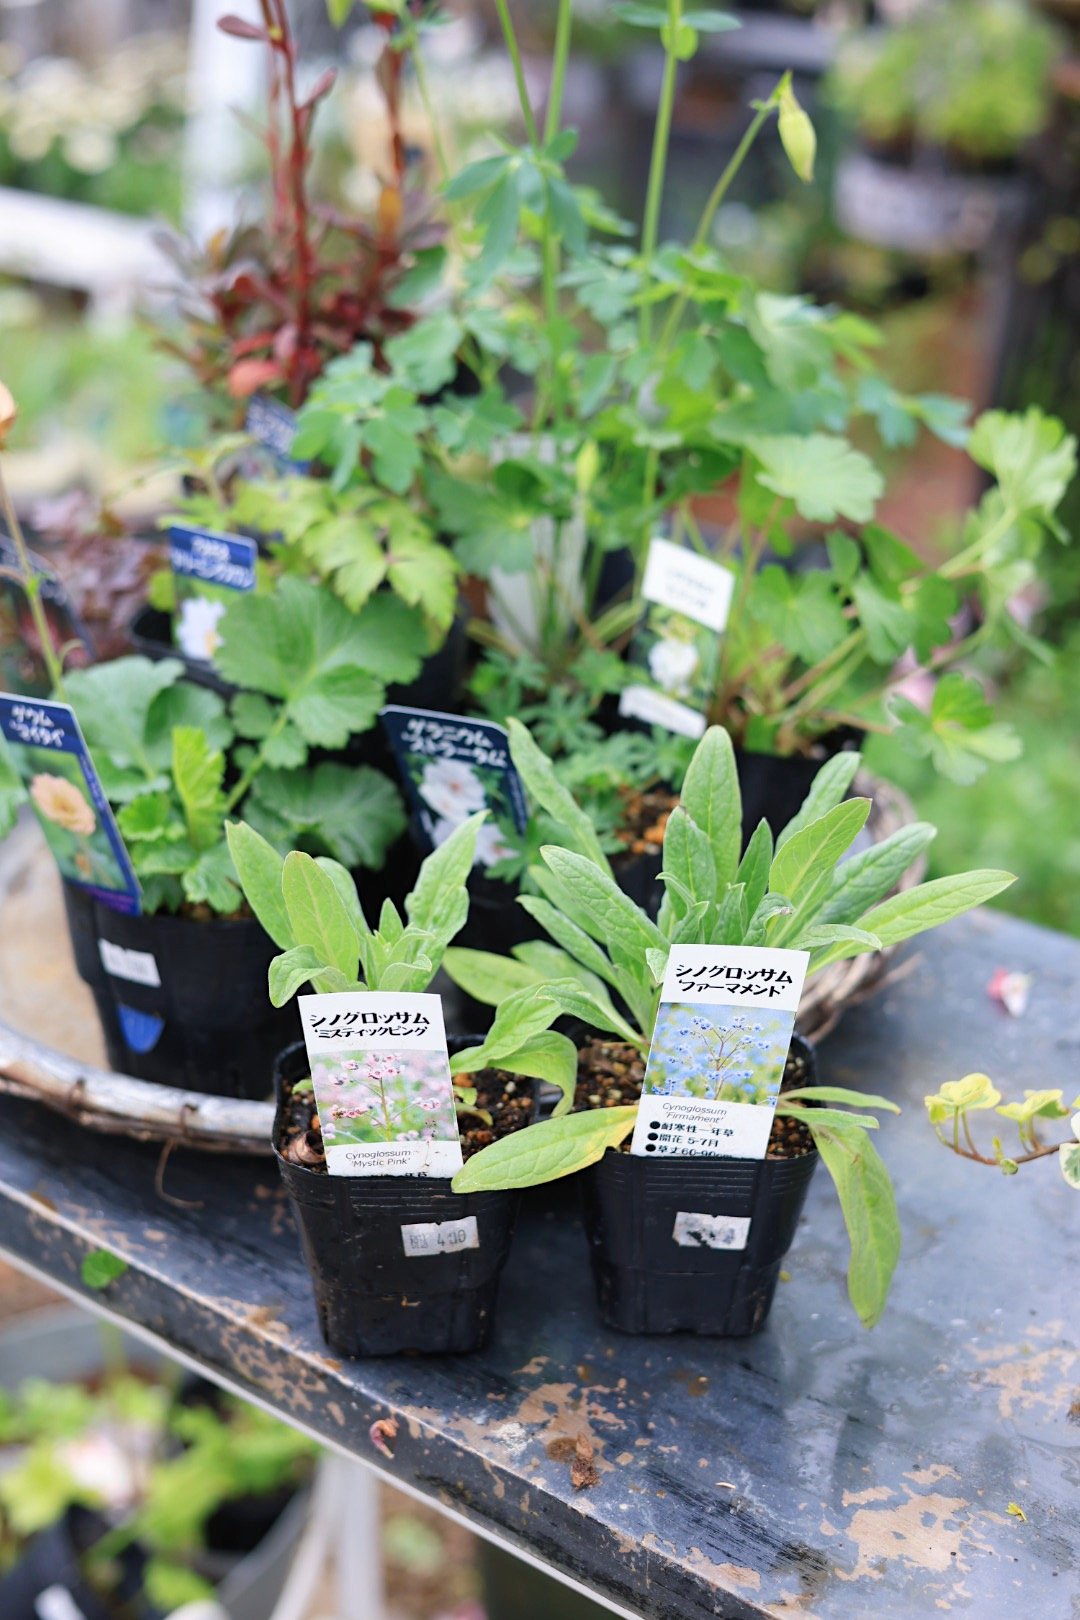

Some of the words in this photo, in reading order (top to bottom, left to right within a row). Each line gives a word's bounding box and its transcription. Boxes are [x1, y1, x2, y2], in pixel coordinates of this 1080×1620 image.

[675, 964, 793, 984] シノグロッサム
[309, 1012, 431, 1028] シノグロッサム
[662, 1102, 728, 1116] Cynoglossum
[660, 1121, 735, 1138] 耐寒性一年草
[345, 1150, 411, 1159] Cynoglossum
